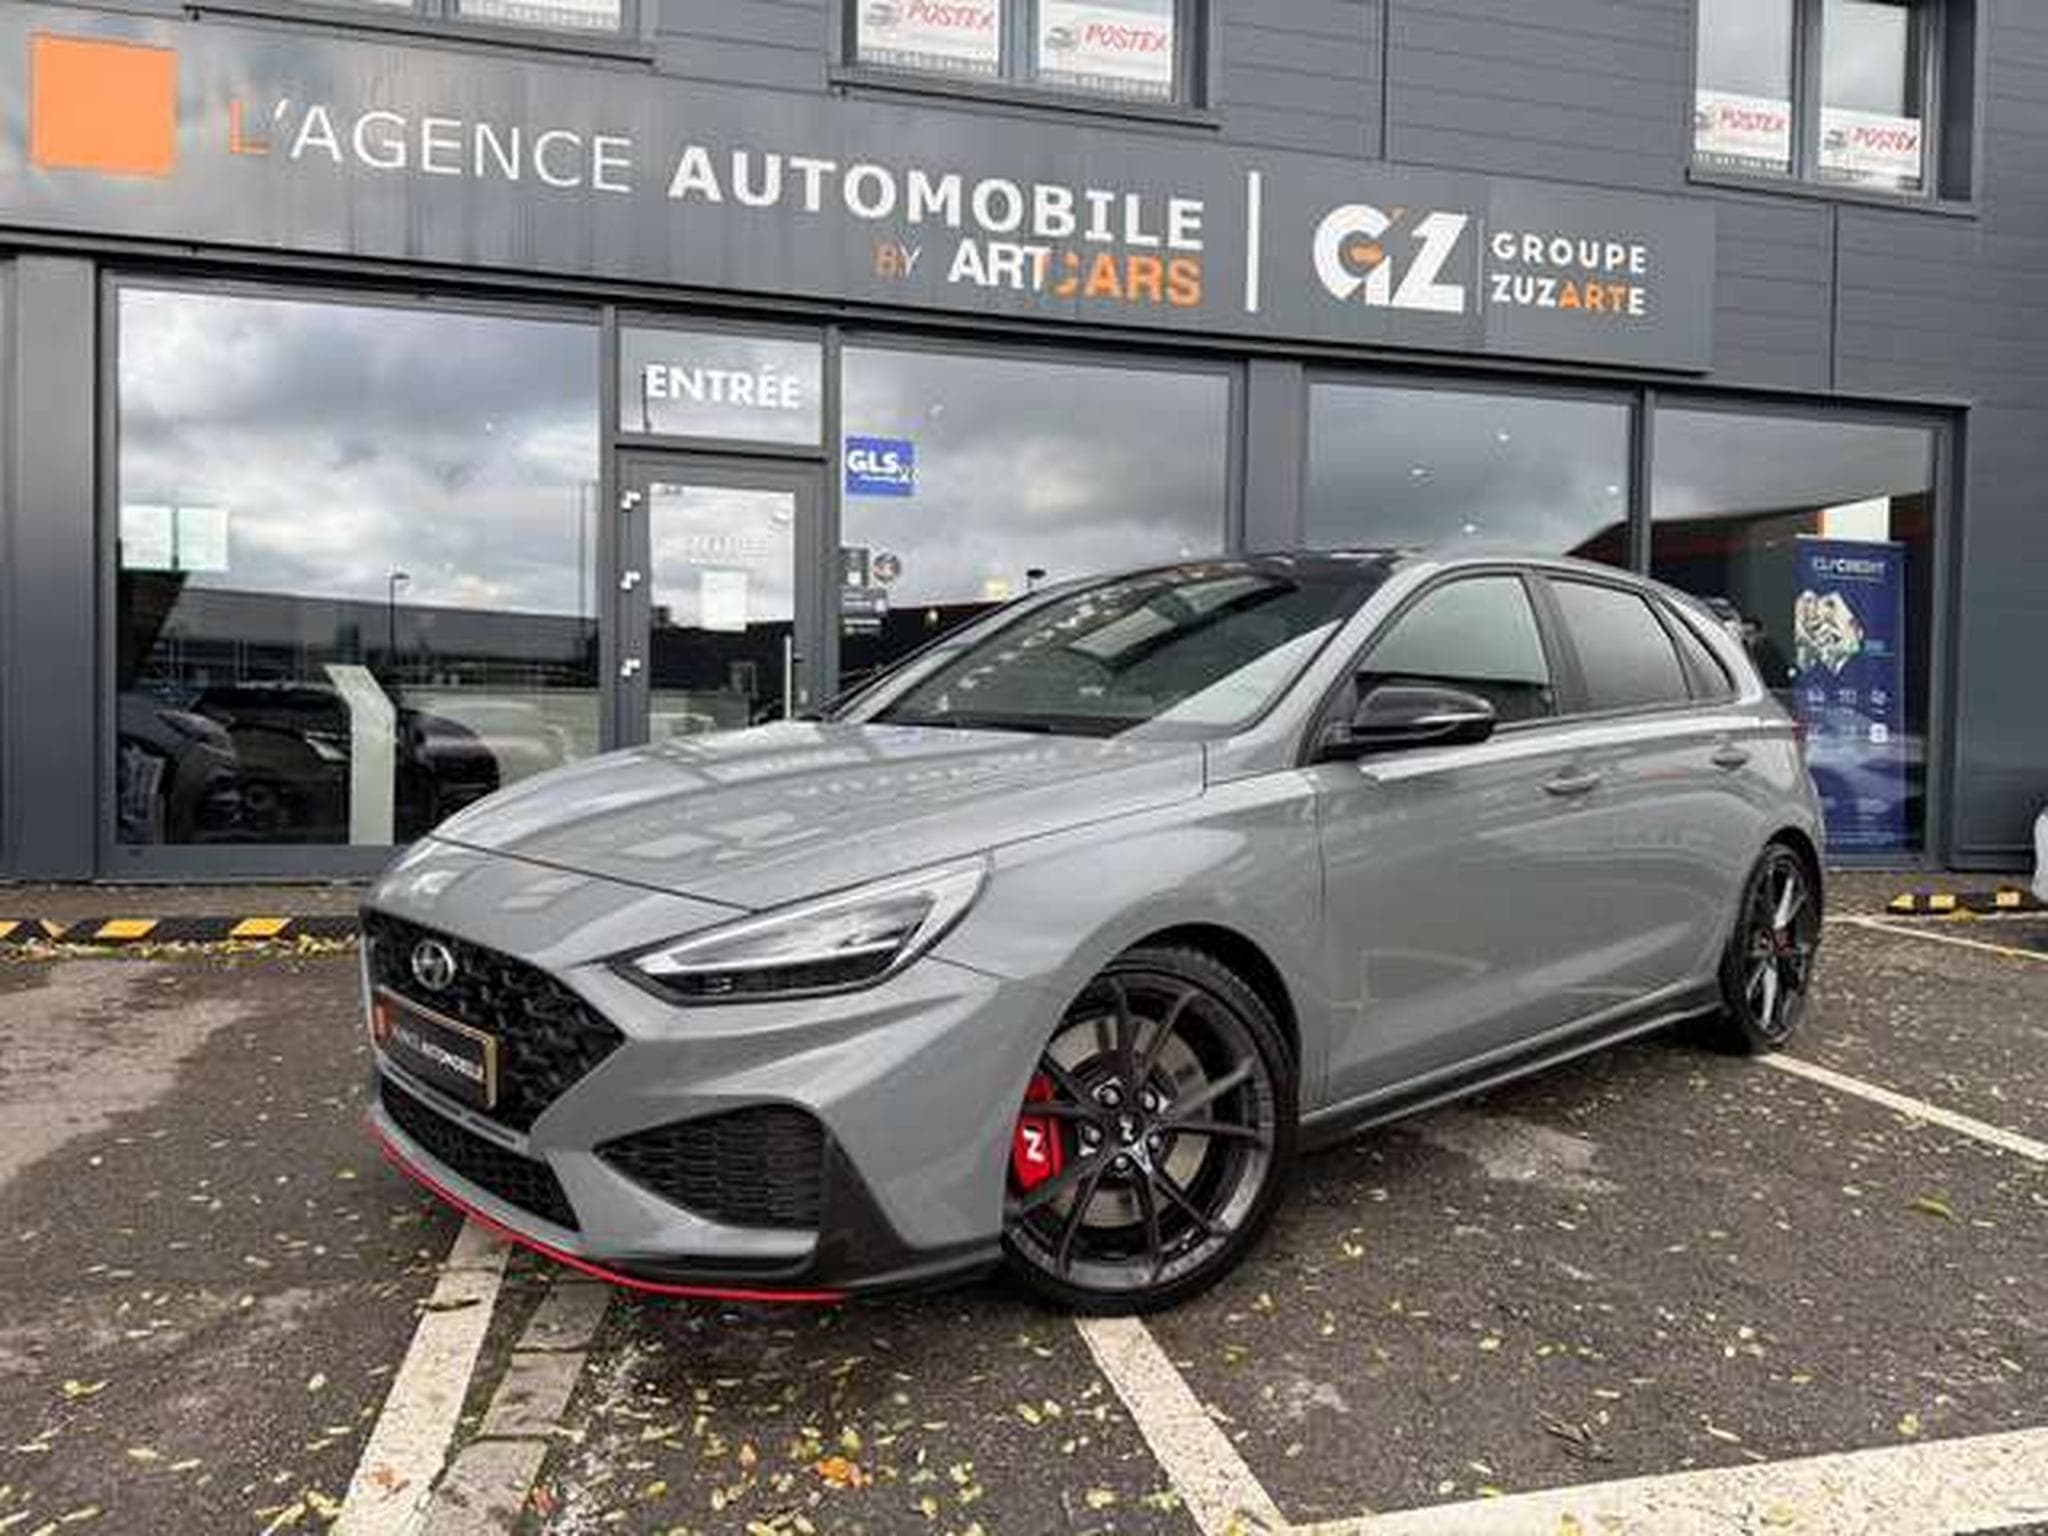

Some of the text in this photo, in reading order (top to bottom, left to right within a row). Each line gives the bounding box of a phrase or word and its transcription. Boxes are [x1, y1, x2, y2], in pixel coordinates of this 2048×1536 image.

[1083, 23, 1169, 52] POSTEX
[228, 99, 1204, 250] L'AGENCE AUTOMOBILE
[874, 240, 921, 280] BY
[1492, 231, 1648, 275] GROUPE
[1492, 274, 1648, 316] ZUZARTE
[646, 363, 801, 409] ENTRÉE
[848, 449, 898, 473] GLS
